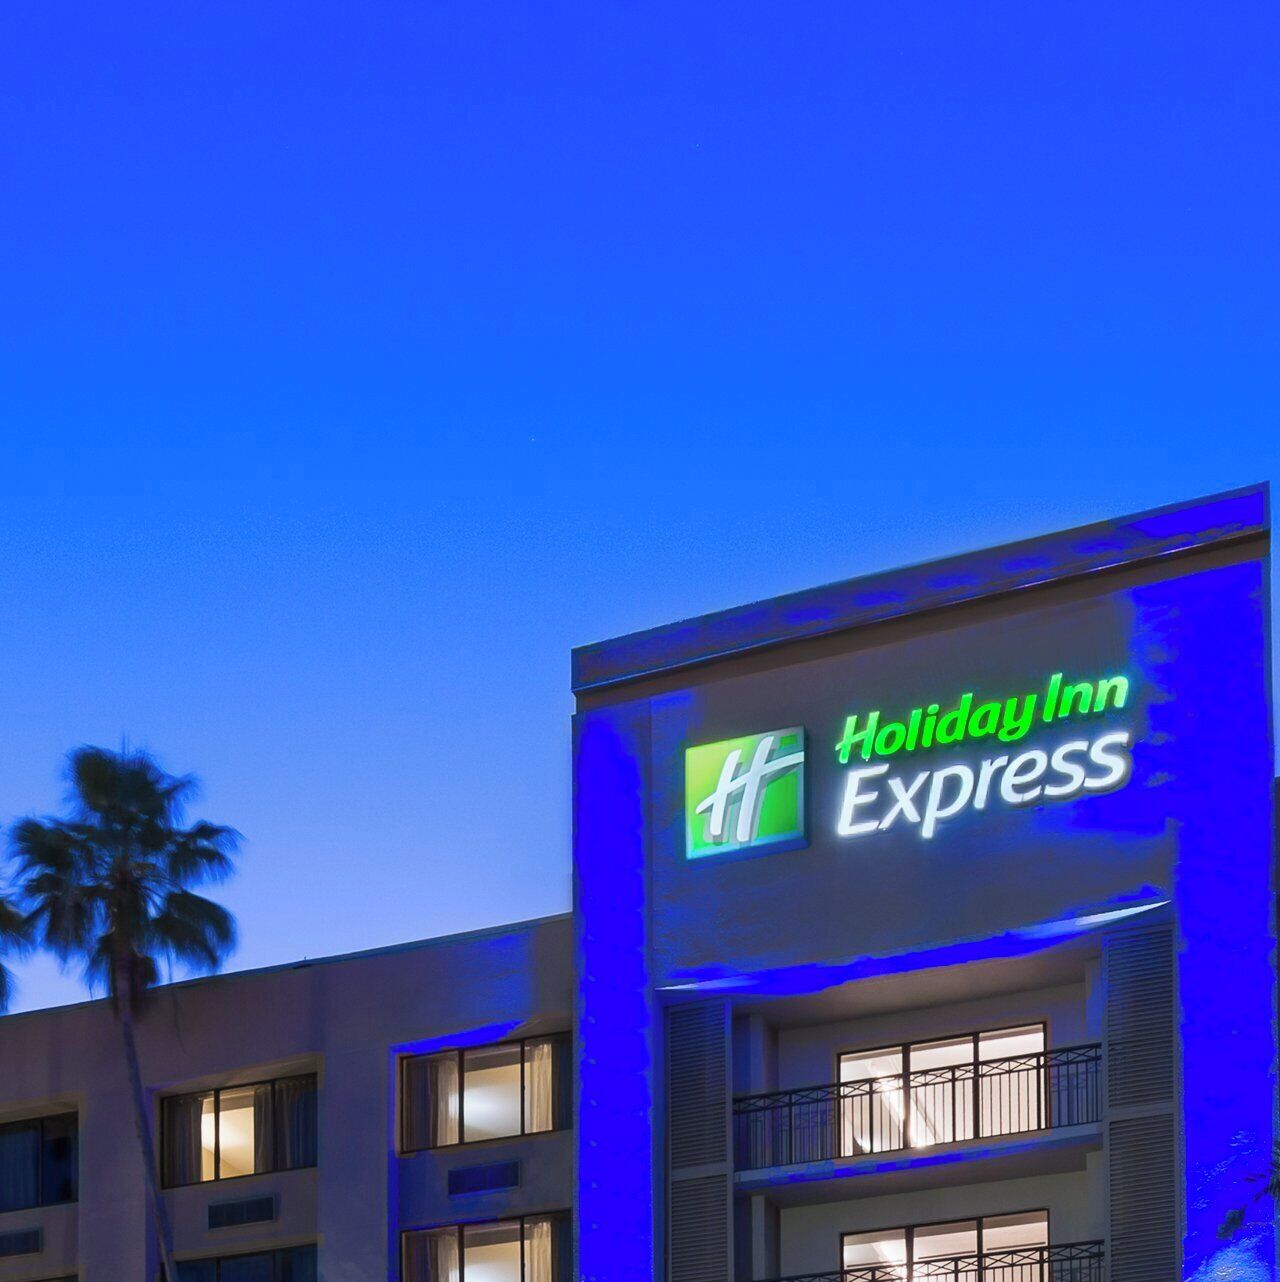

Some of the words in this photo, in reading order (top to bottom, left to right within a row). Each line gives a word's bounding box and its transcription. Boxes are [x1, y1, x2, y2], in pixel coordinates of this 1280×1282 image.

[835, 692, 1038, 763] Holiday
[1042, 672, 1129, 722] Inn
[837, 732, 1130, 838] Express
